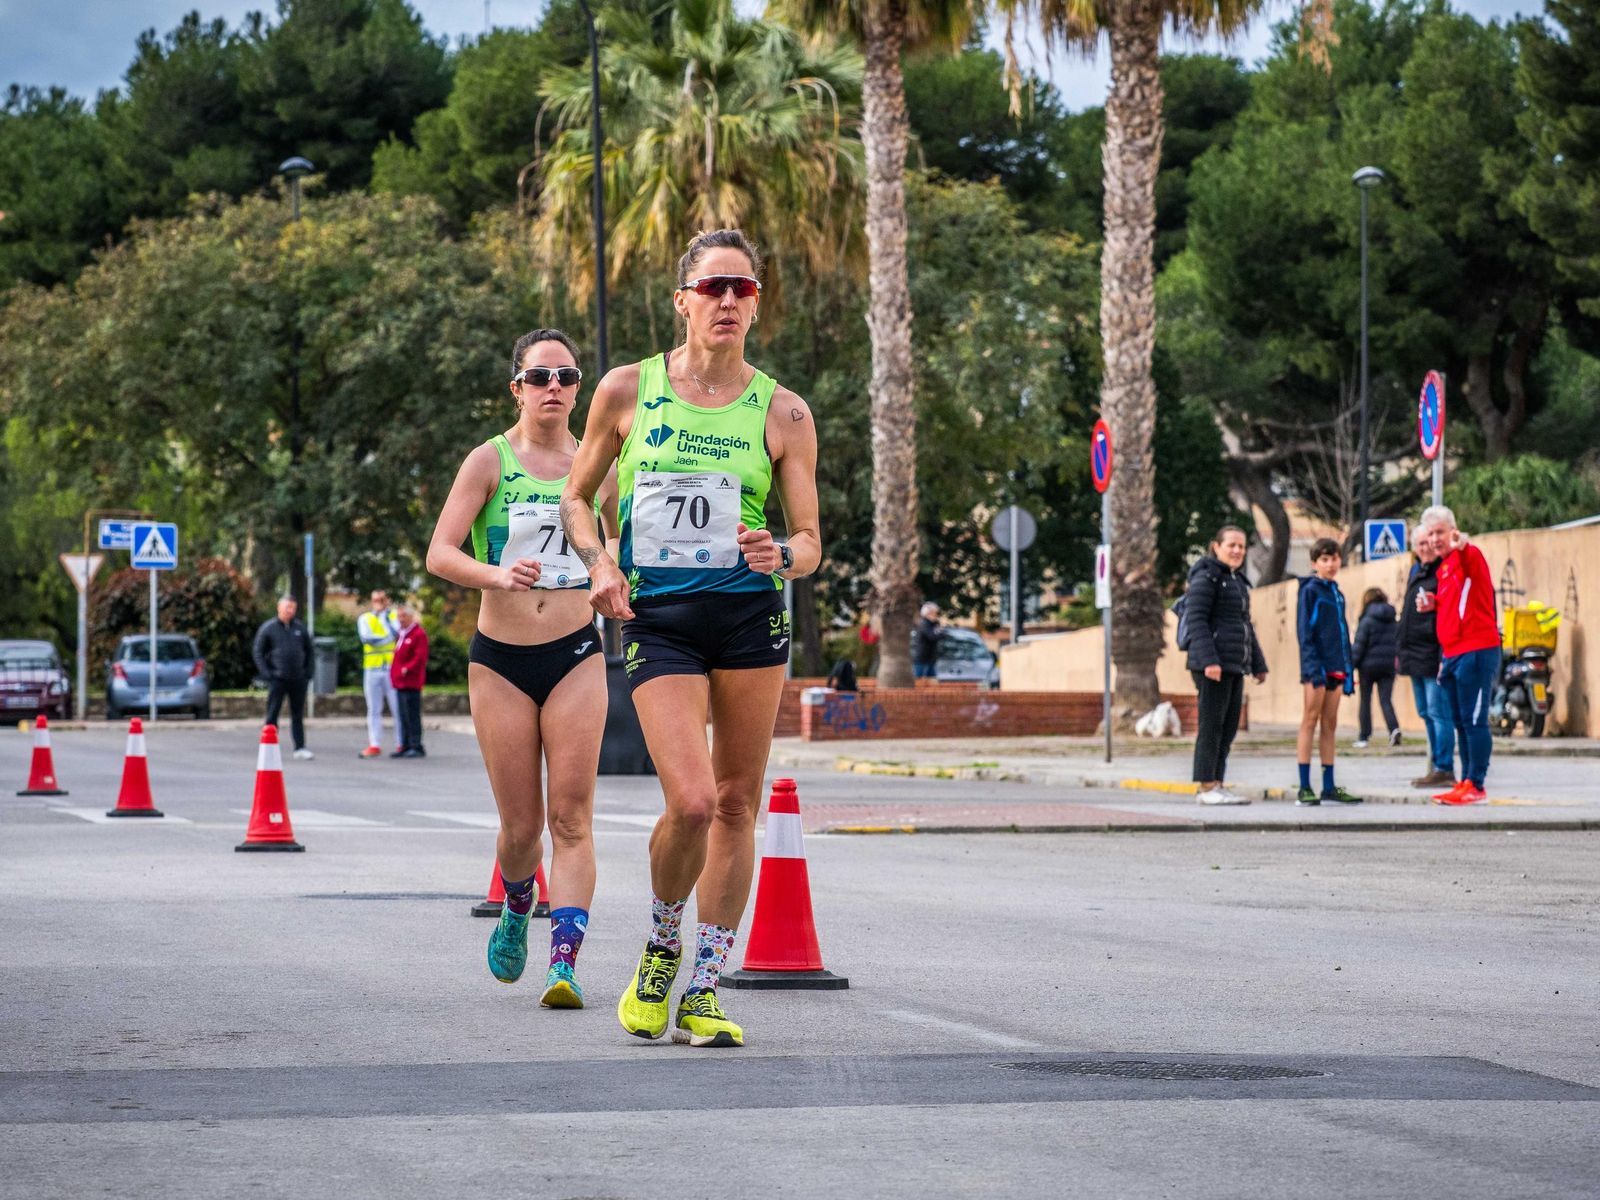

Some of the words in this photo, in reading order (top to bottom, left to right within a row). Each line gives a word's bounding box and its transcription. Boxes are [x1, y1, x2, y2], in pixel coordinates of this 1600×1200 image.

[677, 441, 730, 460] Unicaja
[679, 429, 750, 451] Fundación
[674, 456, 698, 466] Jaén
[665, 496, 710, 529] 70
[538, 525, 570, 556] 71
